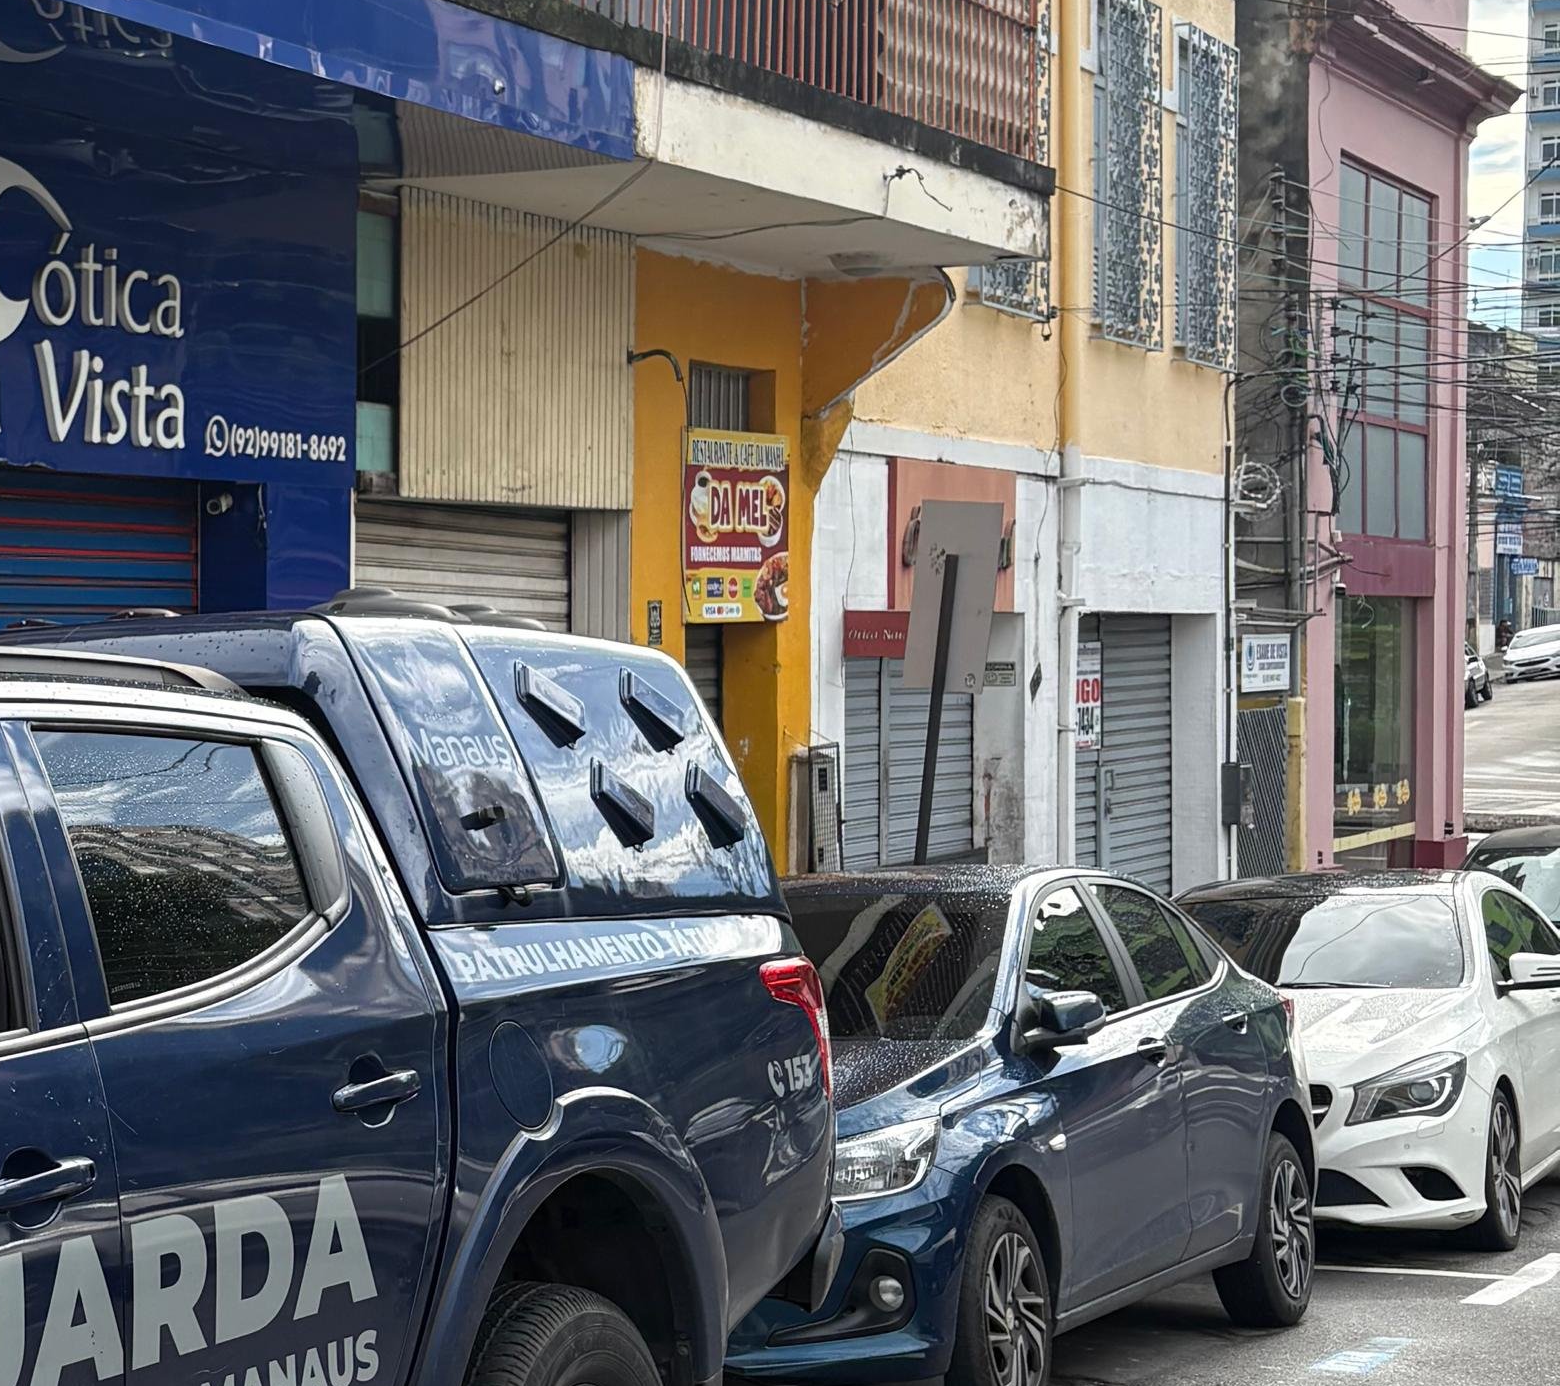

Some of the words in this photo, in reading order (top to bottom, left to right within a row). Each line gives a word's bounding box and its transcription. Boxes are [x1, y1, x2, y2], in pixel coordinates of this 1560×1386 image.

[35, 232, 186, 341] ótica
[35, 338, 186, 451] Vista
[230, 421, 348, 464] (92)99181-8692
[692, 439, 732, 465] RESTAURANTE
[711, 486, 731, 527] DA
[737, 486, 768, 528] MEL
[691, 547, 730, 563] FORNECEMOS
[731, 547, 762, 563] MARMITAS
[402, 727, 512, 767] Manaus
[459, 931, 664, 984] PATRULHAMENTO
[784, 1054, 814, 1091] 153
